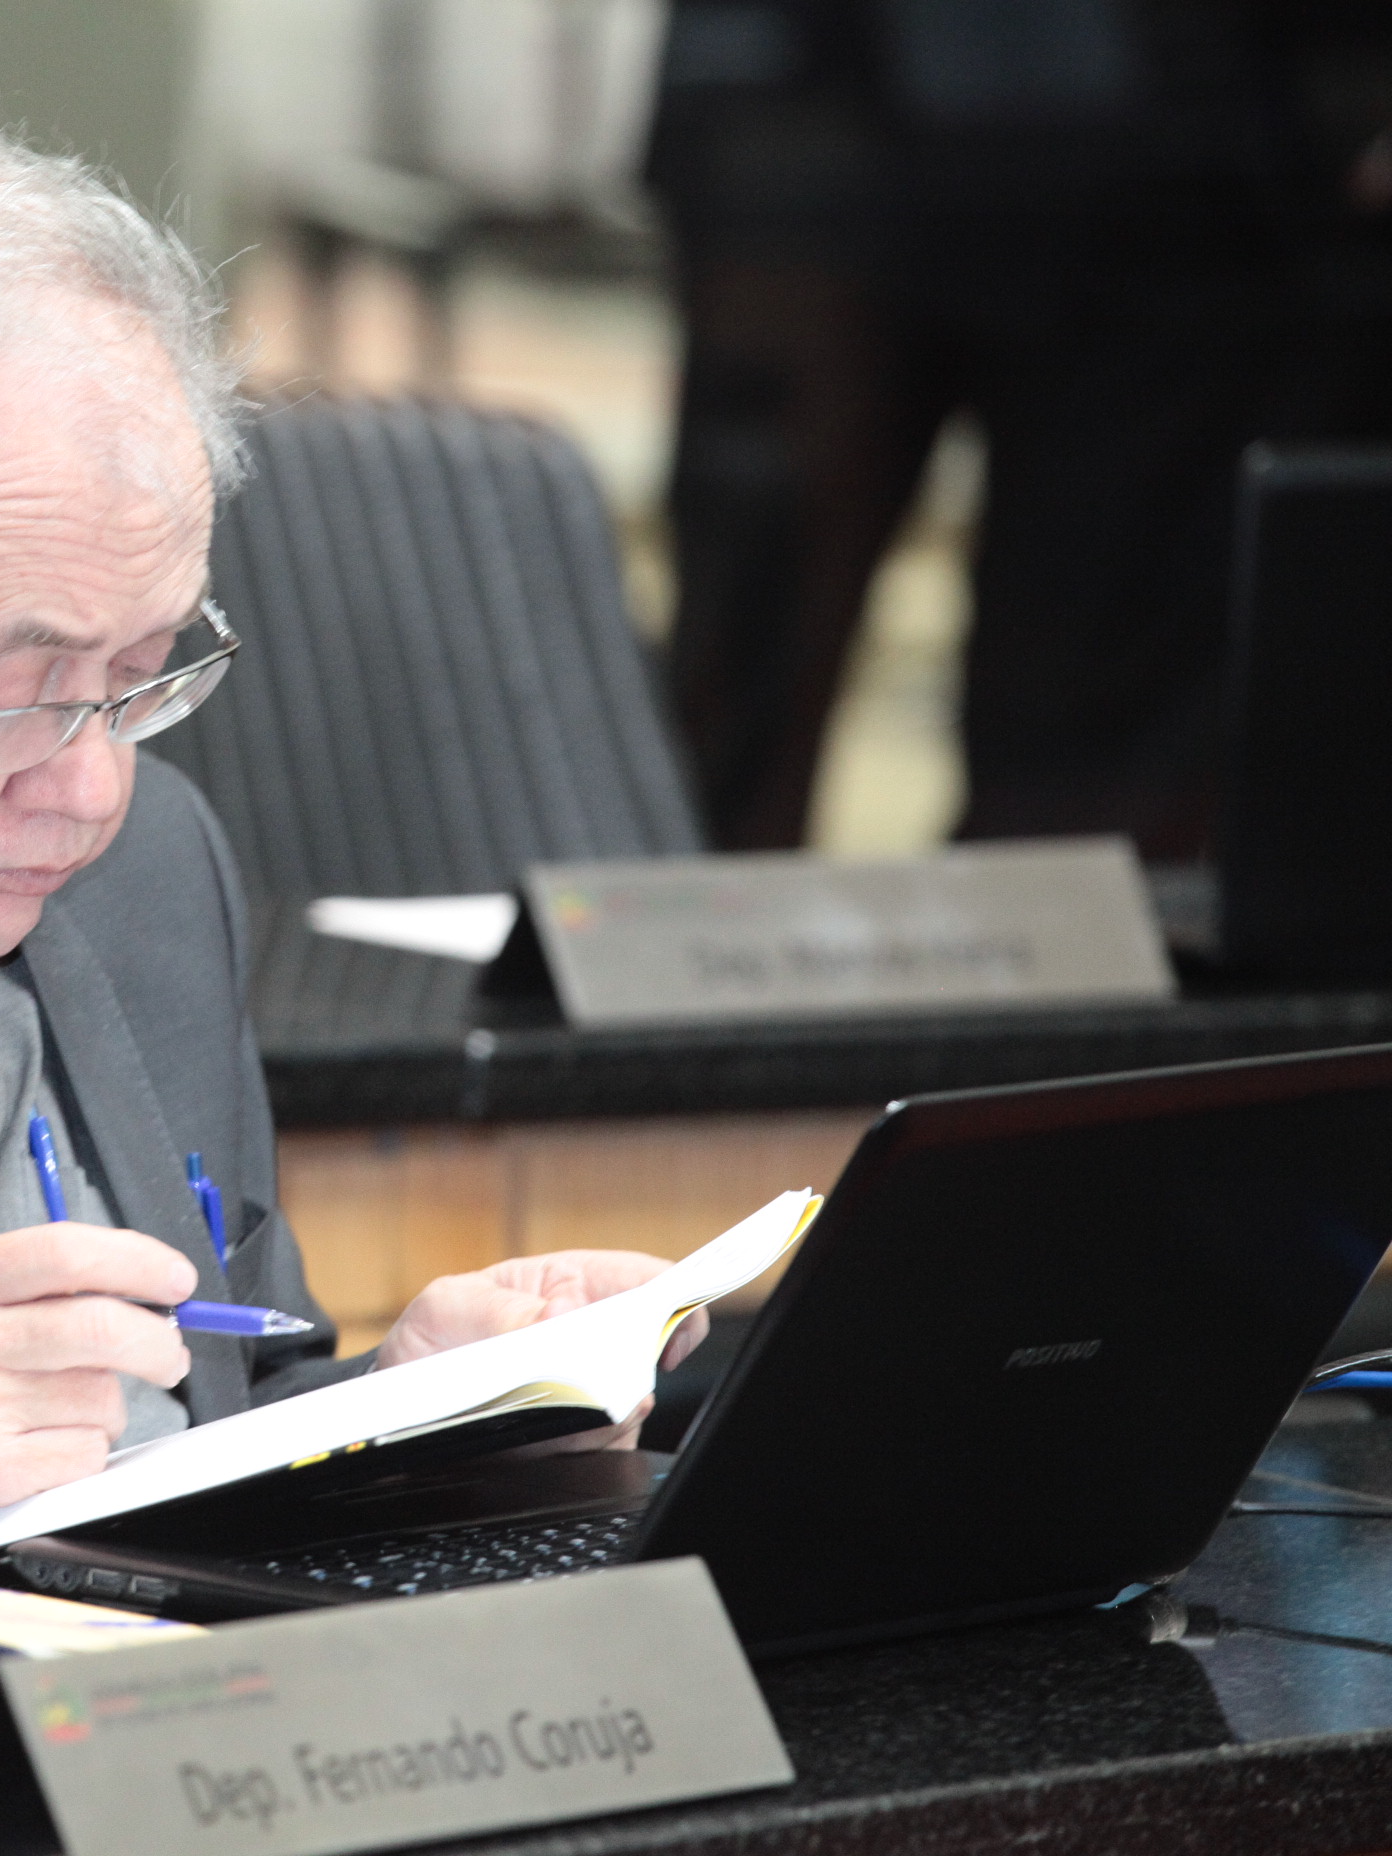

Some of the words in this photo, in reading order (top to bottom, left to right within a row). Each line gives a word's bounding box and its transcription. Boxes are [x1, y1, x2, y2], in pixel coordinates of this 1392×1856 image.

[178, 1760, 297, 1832] Dep.
[293, 1713, 505, 1804] Fernando
[508, 1697, 655, 1775] Coruja
